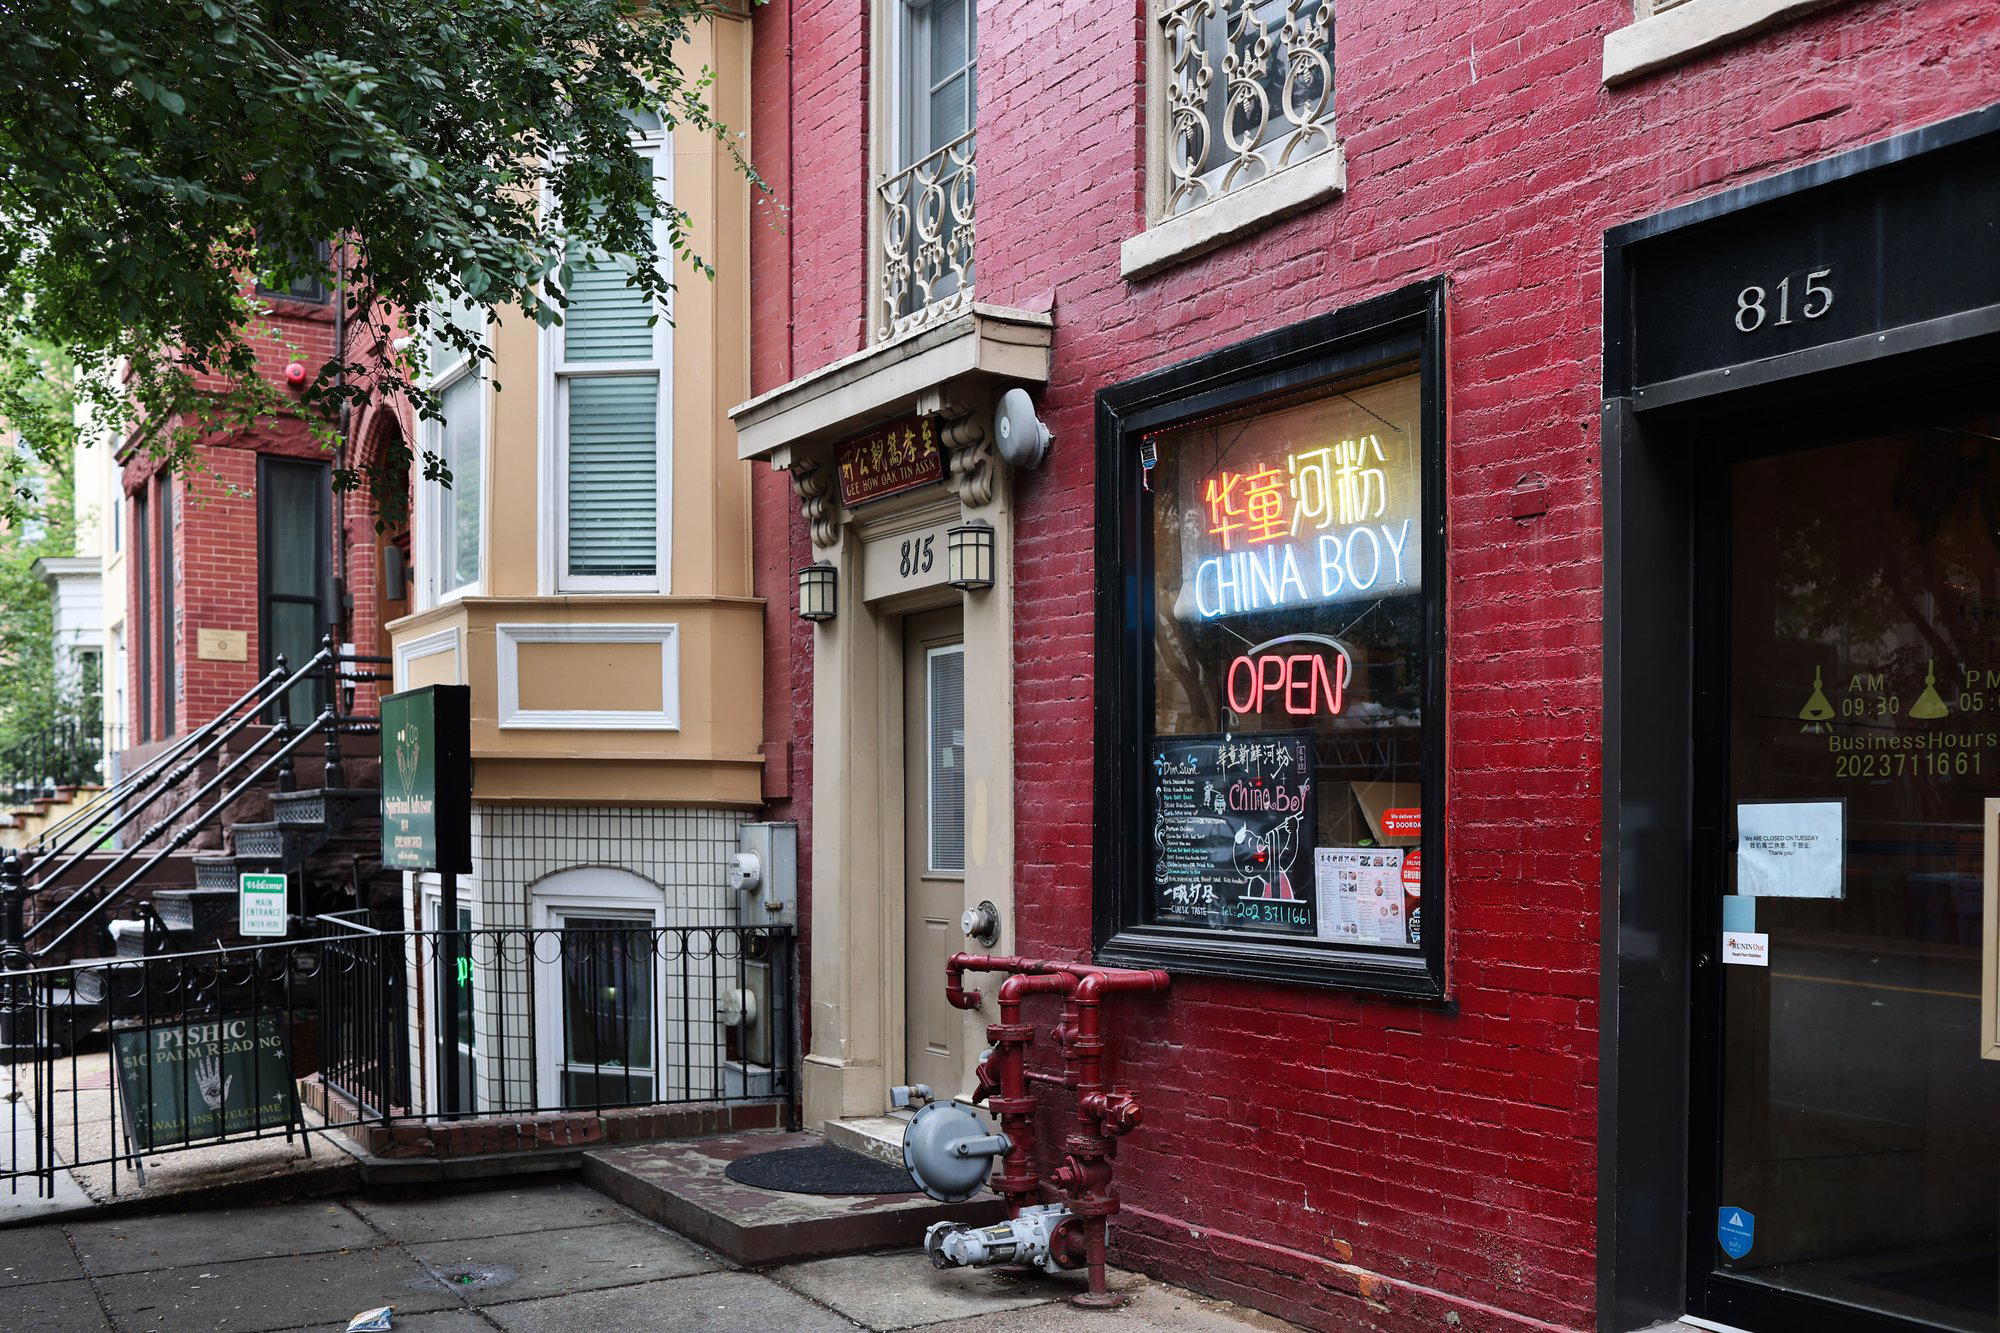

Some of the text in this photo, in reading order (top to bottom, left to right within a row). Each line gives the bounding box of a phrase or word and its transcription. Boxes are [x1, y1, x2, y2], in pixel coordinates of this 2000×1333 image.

[1734, 268, 1834, 332] 815
[846, 481, 862, 496] GEE
[863, 475, 879, 492] HOW
[881, 472, 898, 486] OAK
[900, 465, 913, 480] TIN
[1205, 433, 1388, 550] 华童河粉
[899, 534, 935, 577] 815
[1195, 518, 1412, 618] CHINA BOY
[1228, 654, 1344, 715] OPEN
[1848, 673, 1885, 692] AM
[1842, 695, 1900, 717] 09:30
[1163, 761, 1179, 776] Dim
[1835, 751, 1982, 778] 2023711661
[1229, 779, 1276, 811] China
[246, 908, 281, 917] ENTRANCE
[255, 898, 273, 906] MAIN
[1190, 906, 1207, 916] TASTE
[1237, 902, 1260, 920] 202
[157, 1020, 247, 1050] PYSHIC
[156, 1047, 202, 1064] PALM
[206, 1035, 282, 1057] READNG
[193, 1113, 214, 1125] INS
